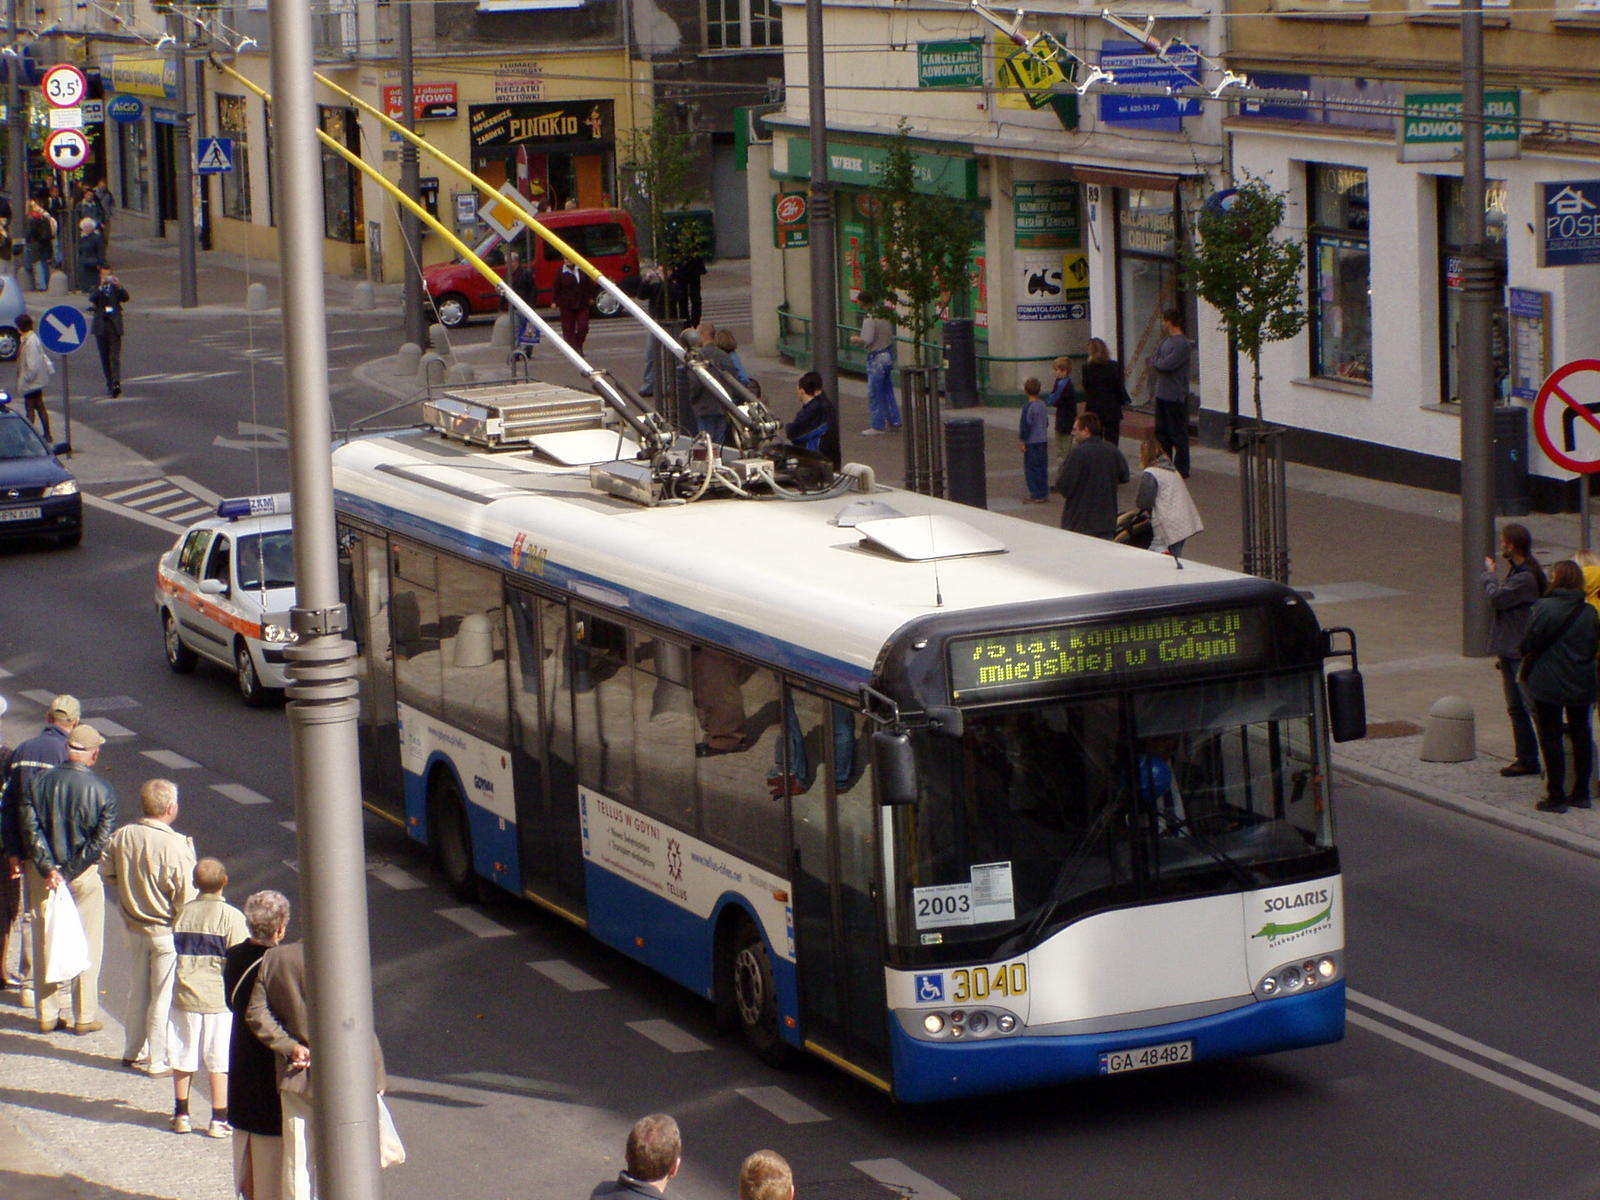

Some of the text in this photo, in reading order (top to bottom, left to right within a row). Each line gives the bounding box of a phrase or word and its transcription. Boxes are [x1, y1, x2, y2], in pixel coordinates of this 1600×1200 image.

[921, 51, 979, 65] KANCELARIE
[921, 63, 980, 77] ADWOKACKIE
[390, 93, 454, 106] sprtowe
[510, 116, 578, 137] PINOKIO
[1088, 186, 1099, 202] 89
[1070, 612, 1242, 649] komunikacji
[979, 632, 1238, 683] miejskiej w Gdyni
[597, 799, 624, 824] TELLUS
[634, 818, 660, 841] GDYNI
[666, 881, 688, 901] TELLUS
[1264, 889, 1328, 913] SOLARIS
[918, 894, 971, 917] 2003
[952, 962, 1027, 1003] 3040
[1110, 1044, 1190, 1072] GA 48482
